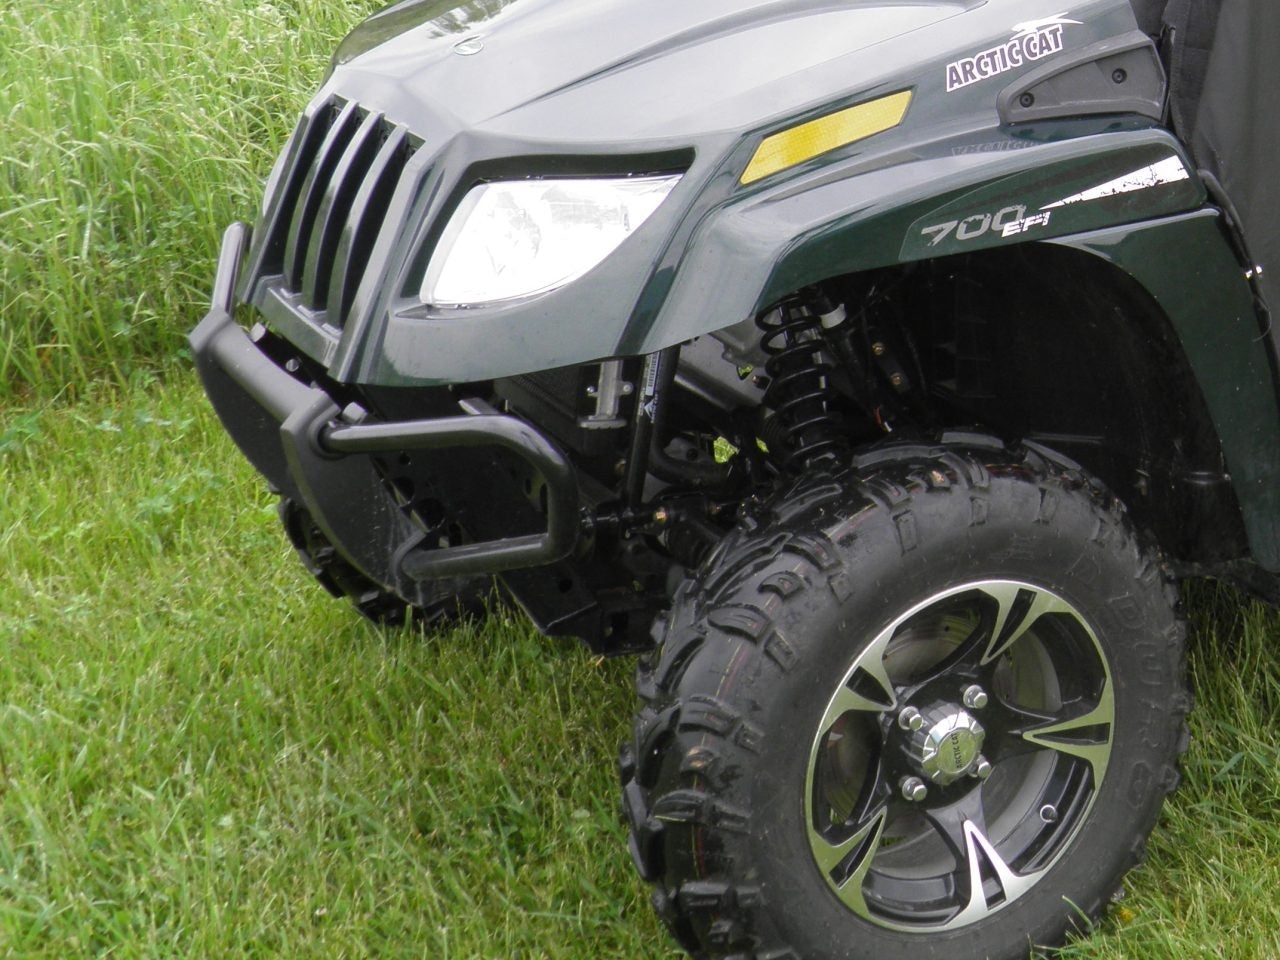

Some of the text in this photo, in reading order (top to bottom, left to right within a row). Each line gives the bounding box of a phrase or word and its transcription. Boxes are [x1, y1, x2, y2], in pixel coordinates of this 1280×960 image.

[946, 24, 1063, 92] ARCTIC CAT
[921, 204, 1027, 246] 700
[953, 745, 964, 769] ARCTIC
